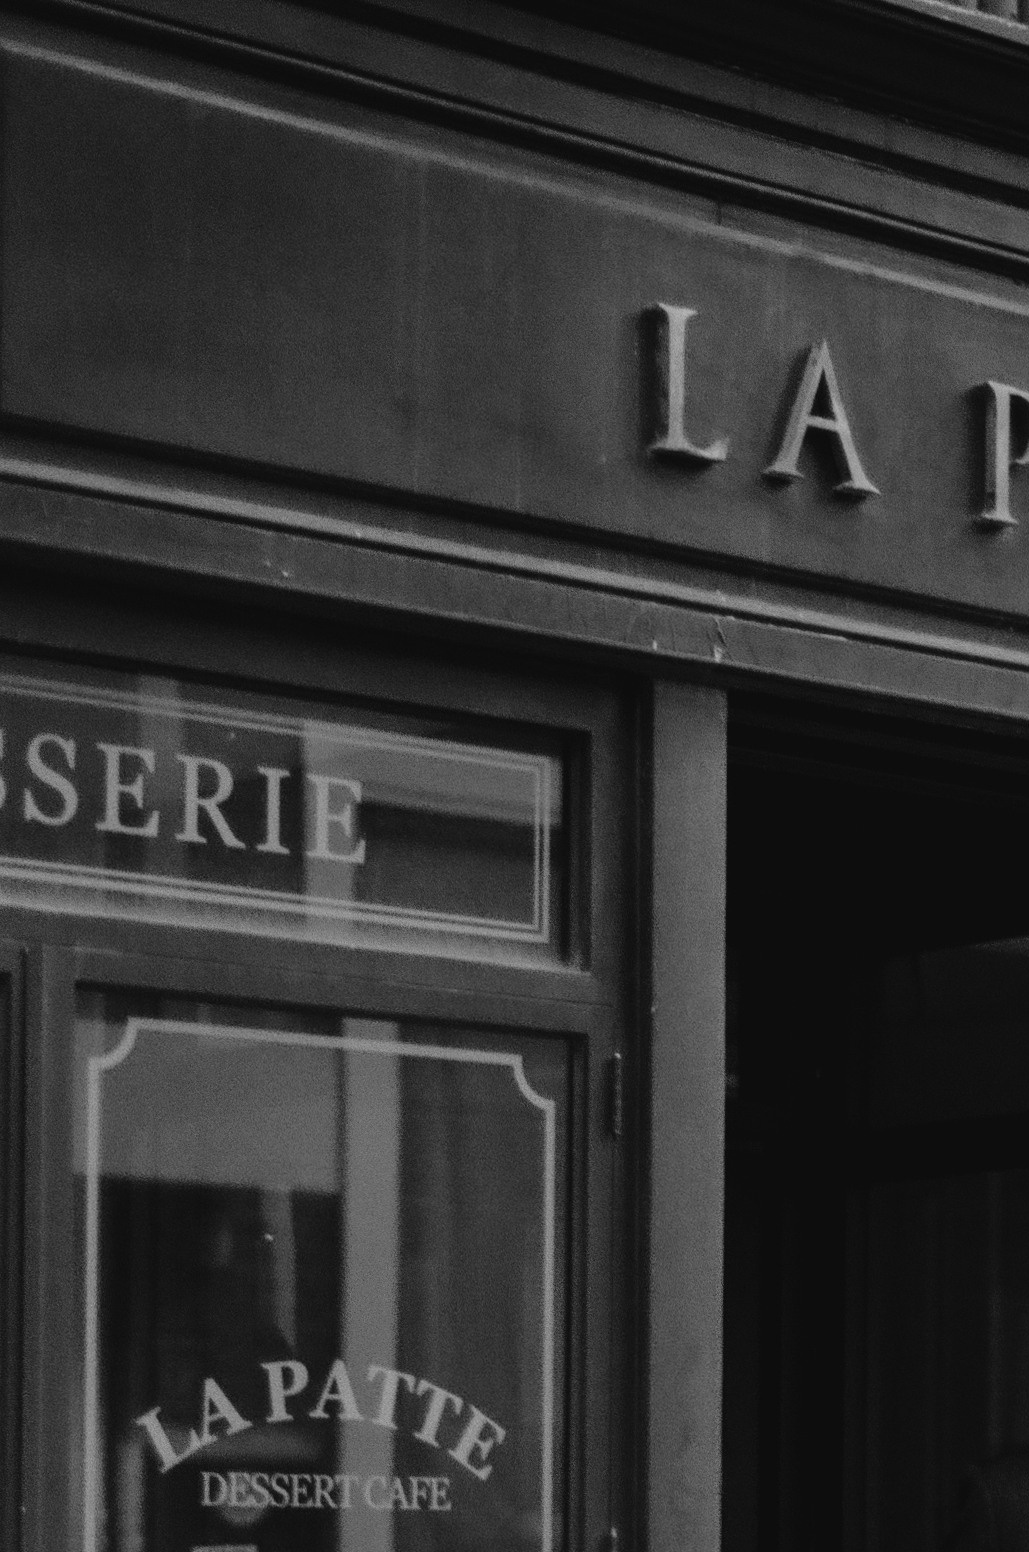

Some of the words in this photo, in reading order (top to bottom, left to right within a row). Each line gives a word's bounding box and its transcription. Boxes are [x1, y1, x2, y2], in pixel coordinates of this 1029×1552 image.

[647, 302, 880, 496] LA
[0, 727, 366, 865] SERIE
[134, 1376, 253, 1474] LA
[260, 1358, 507, 1482] PATTE
[201, 1470, 358, 1509] DESSERT
[363, 1475, 453, 1512] CAFE
